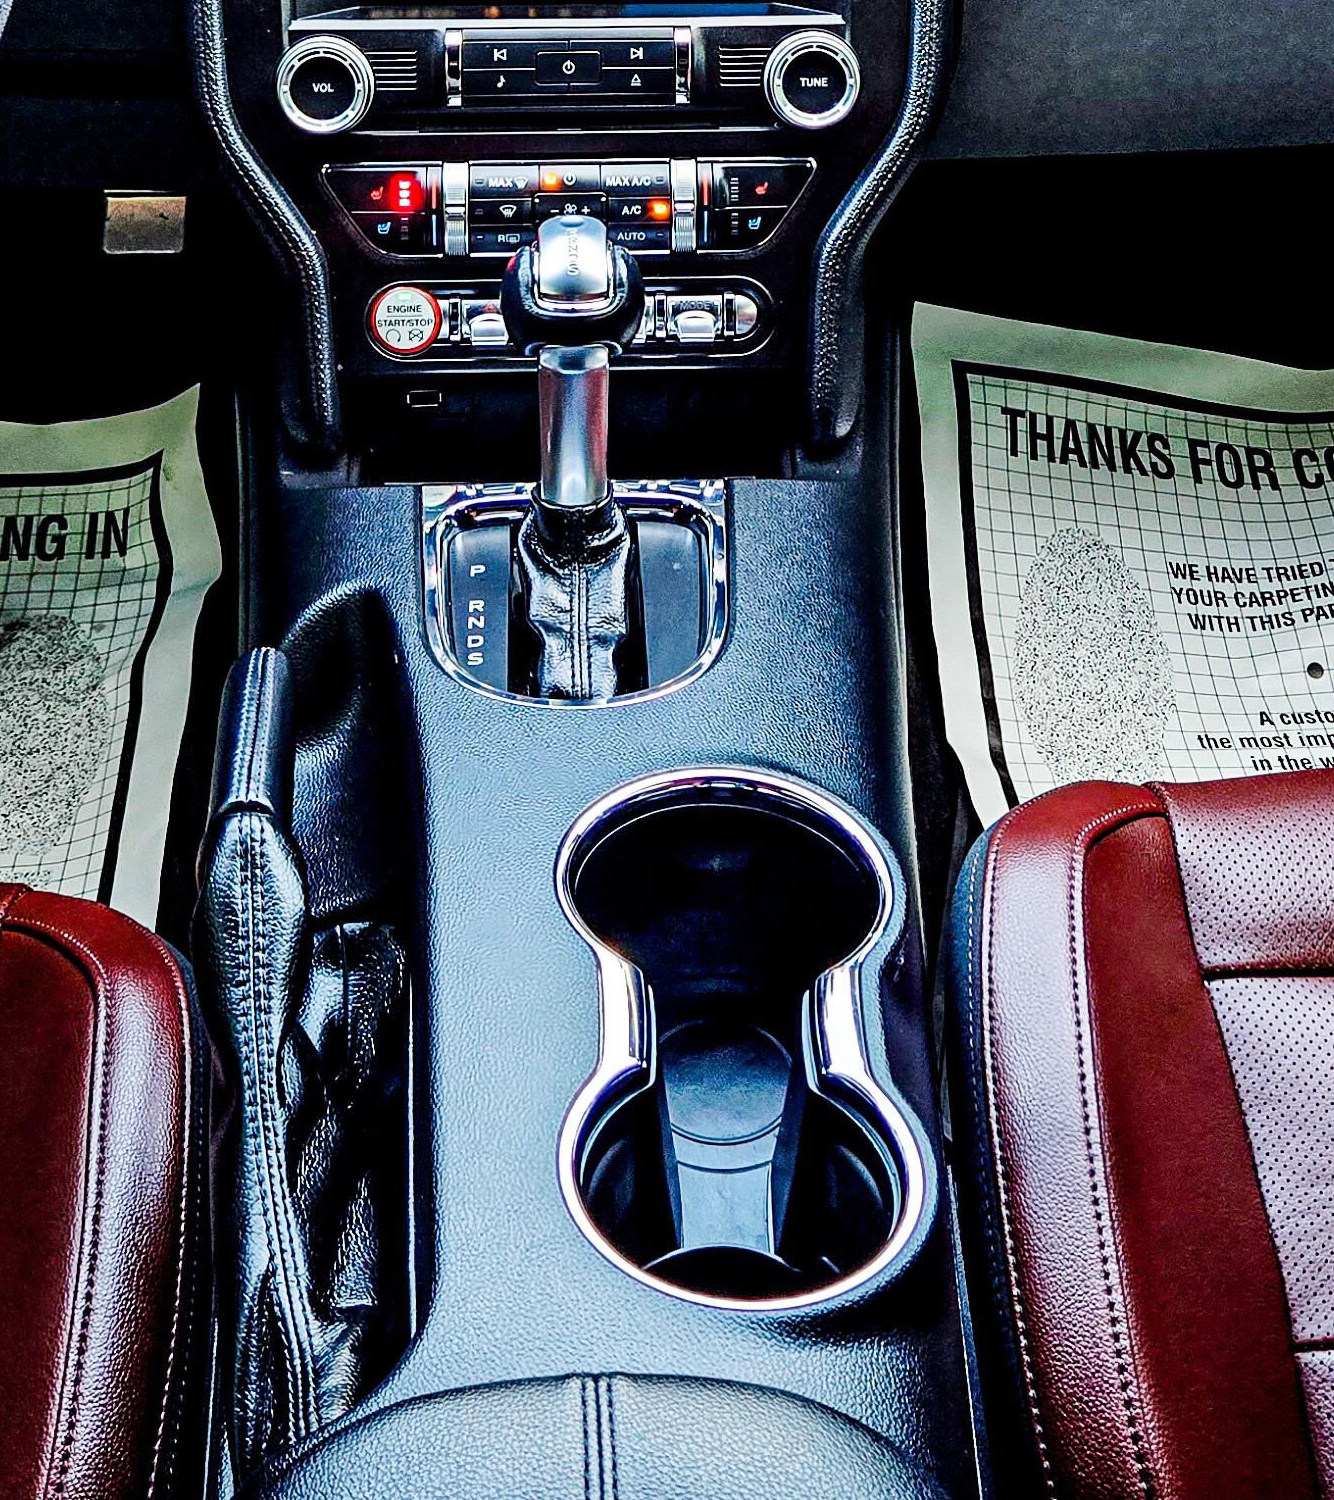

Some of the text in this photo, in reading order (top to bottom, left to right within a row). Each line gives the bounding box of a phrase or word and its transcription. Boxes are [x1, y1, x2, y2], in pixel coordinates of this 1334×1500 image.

[312, 82, 334, 93] VOL
[799, 77, 828, 88] TUNE
[488, 177, 513, 188] MAX
[605, 175, 651, 187] MAX A/C
[621, 205, 642, 216] A/C
[617, 232, 646, 241] AUTO
[386, 303, 423, 314] ENGINE
[679, 300, 712, 311] MODE
[377, 318, 433, 328] START/STOP
[1001, 406, 1175, 482] THANKS
[1189, 438, 1281, 492] FOR
[86, 508, 131, 559] IN
[470, 565, 486, 577] P
[1169, 561, 1201, 581] WE
[1206, 565, 1258, 584] HAVE
[1262, 561, 1324, 583] TRIED
[1171, 586, 1229, 608] YOUR
[468, 600, 485, 612] R
[467, 616, 484, 628] N
[1187, 612, 1240, 633] WITH
[1246, 611, 1296, 631] THIS
[467, 635, 484, 648] D
[467, 652, 484, 665] S
[1258, 711, 1274, 726] A
[1197, 734, 1232, 750] the
[1239, 732, 1293, 749] most
[1250, 755, 1271, 772] in
[1278, 753, 1312, 771] the
